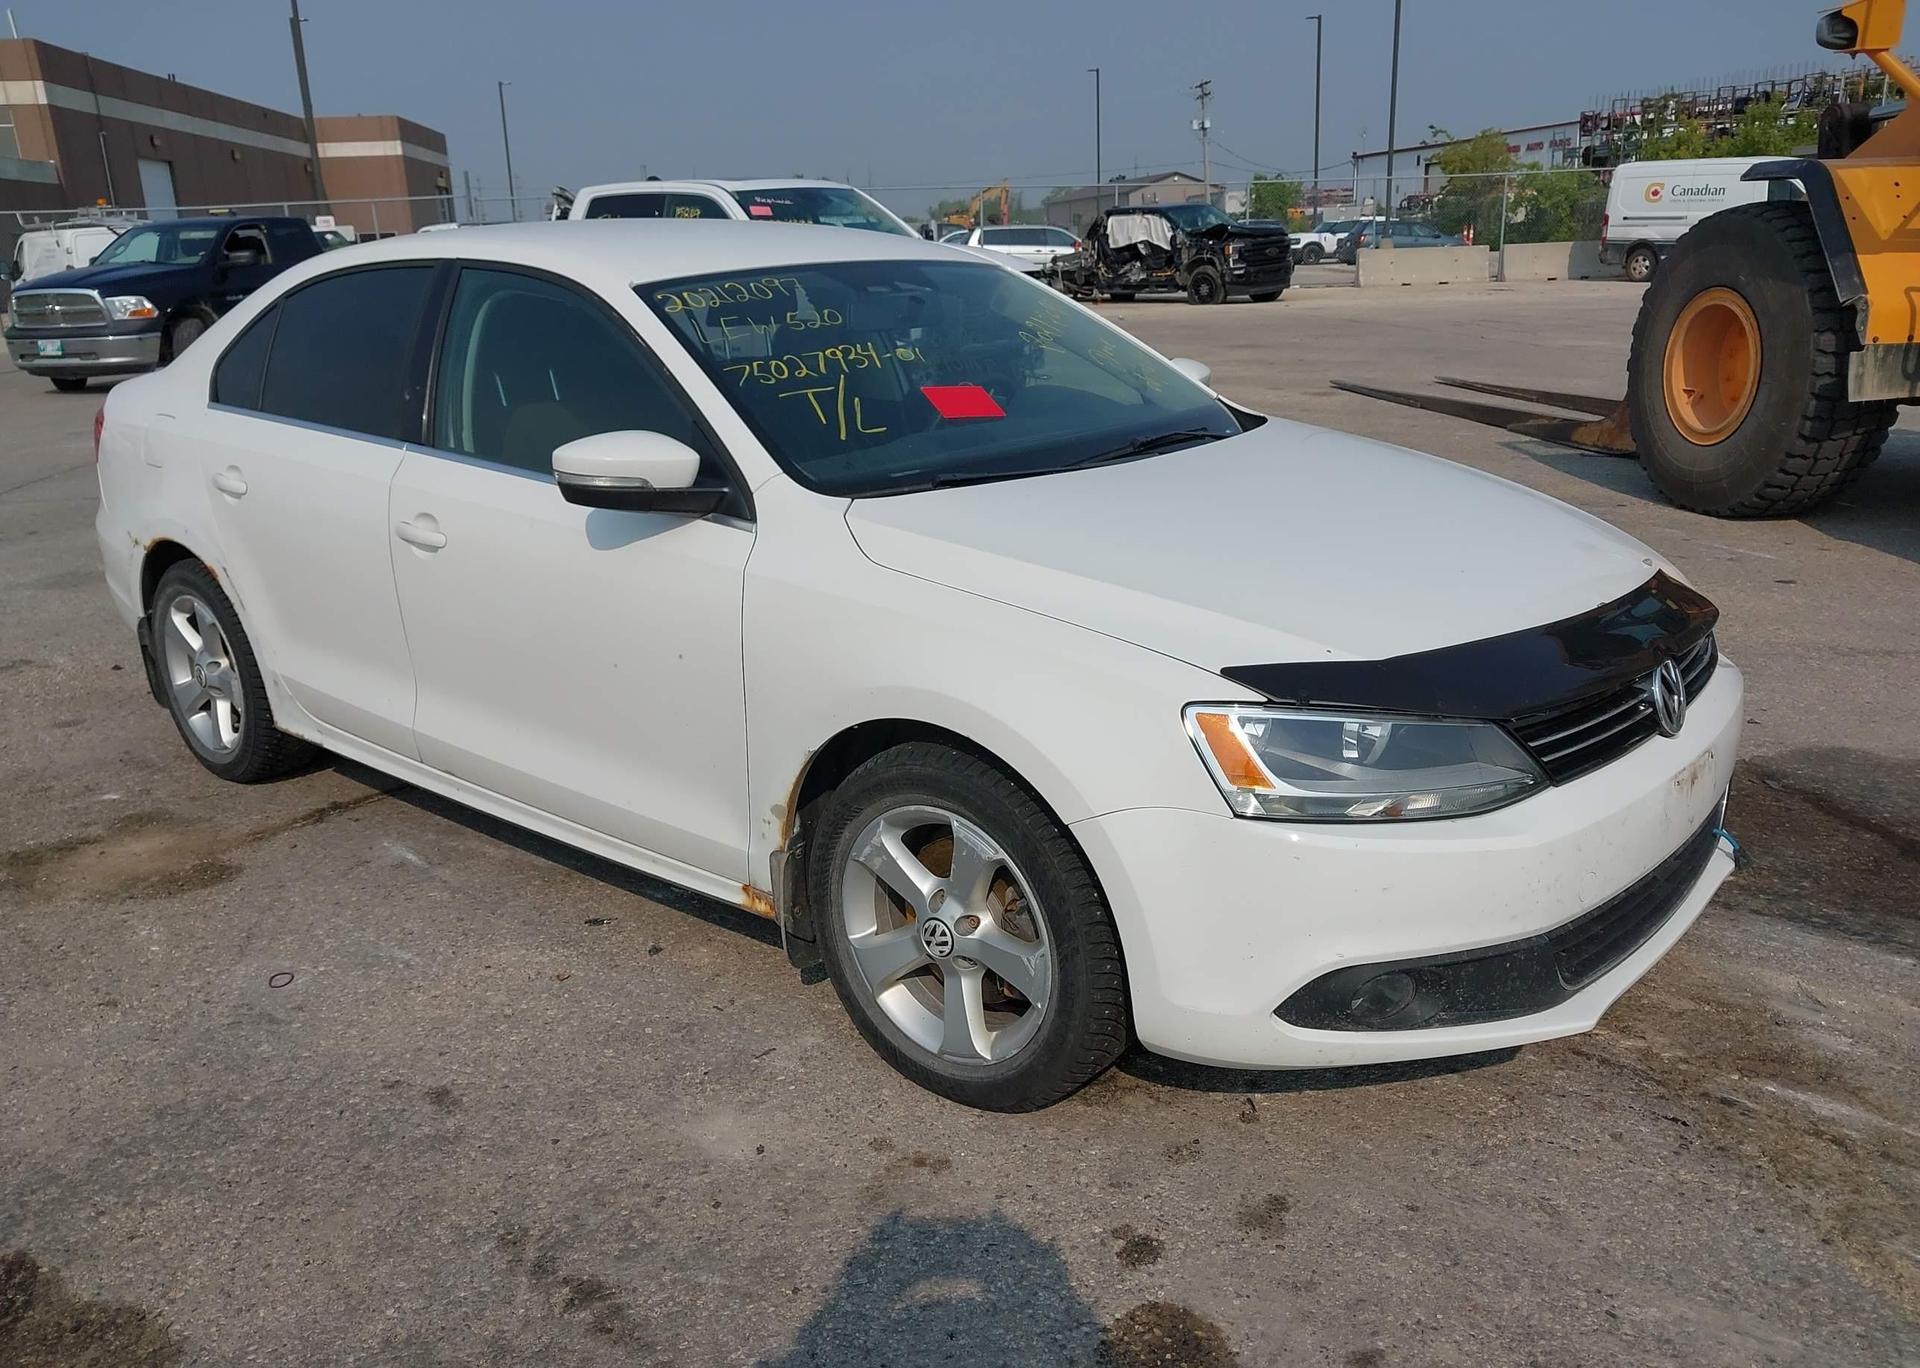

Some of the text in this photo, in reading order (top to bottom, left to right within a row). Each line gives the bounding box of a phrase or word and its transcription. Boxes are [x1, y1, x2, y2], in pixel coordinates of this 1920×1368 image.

[1671, 183, 1726, 197] Canadian
[786, 308, 843, 331] 520
[778, 374, 888, 441] T/L
